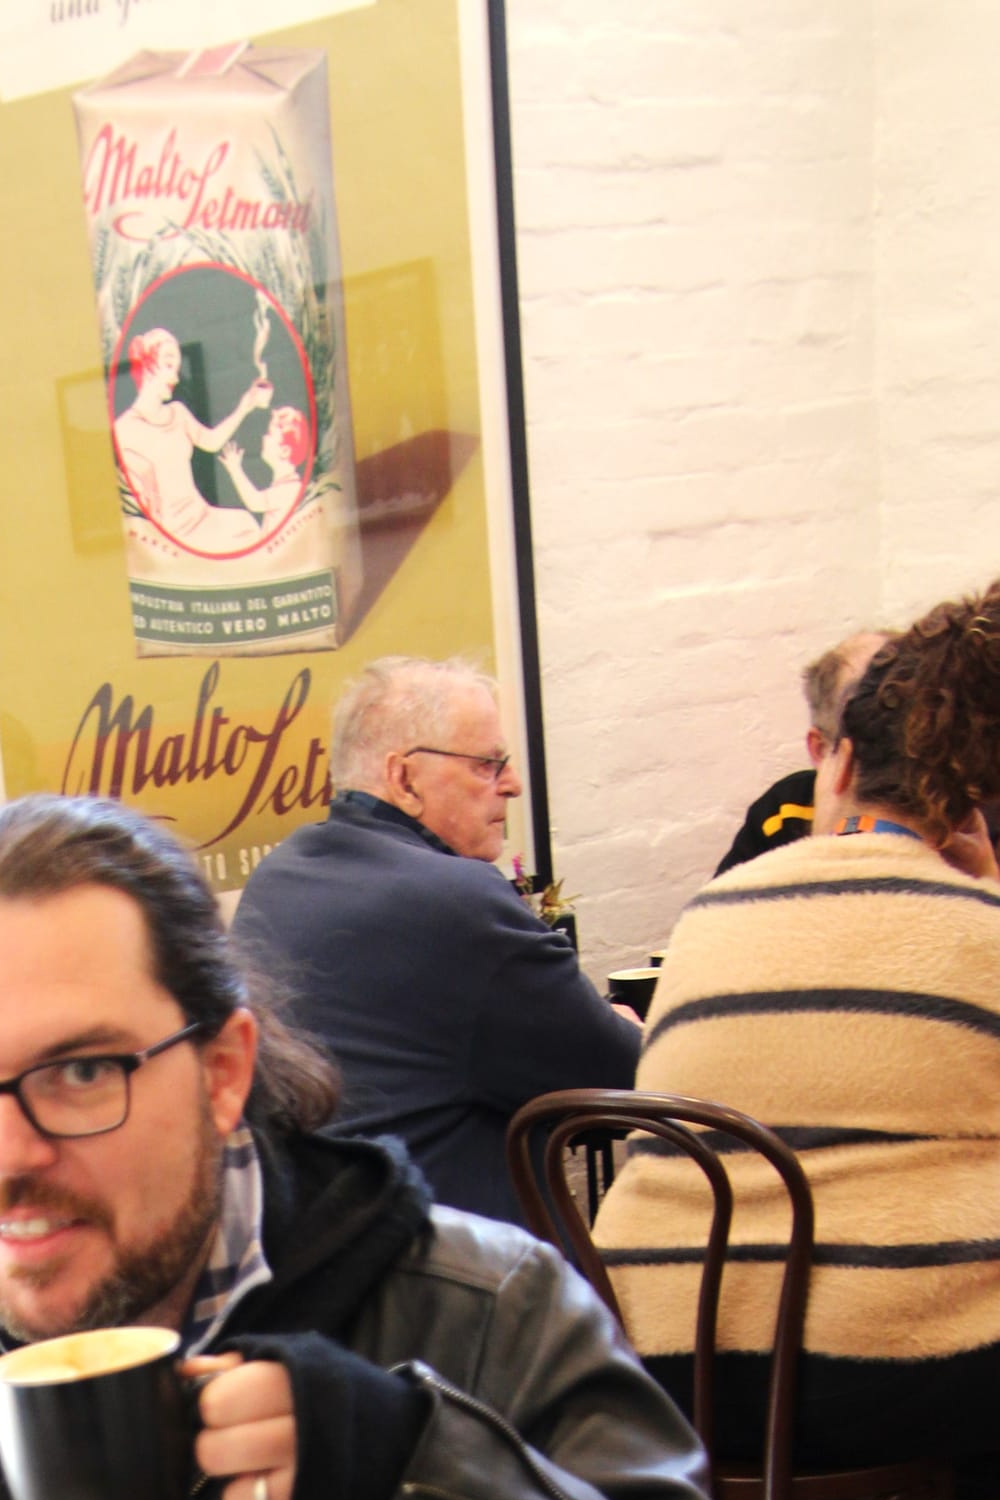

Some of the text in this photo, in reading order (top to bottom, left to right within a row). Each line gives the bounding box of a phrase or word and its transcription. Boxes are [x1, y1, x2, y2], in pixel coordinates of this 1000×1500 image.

[150, 617, 214, 635] AUTENTICO
[221, 617, 267, 635] VERO
[277, 604, 333, 627] MALTO
[190, 600, 242, 614] ITALIANA
[247, 597, 268, 611] DEL
[61, 660, 252, 798] Malto
